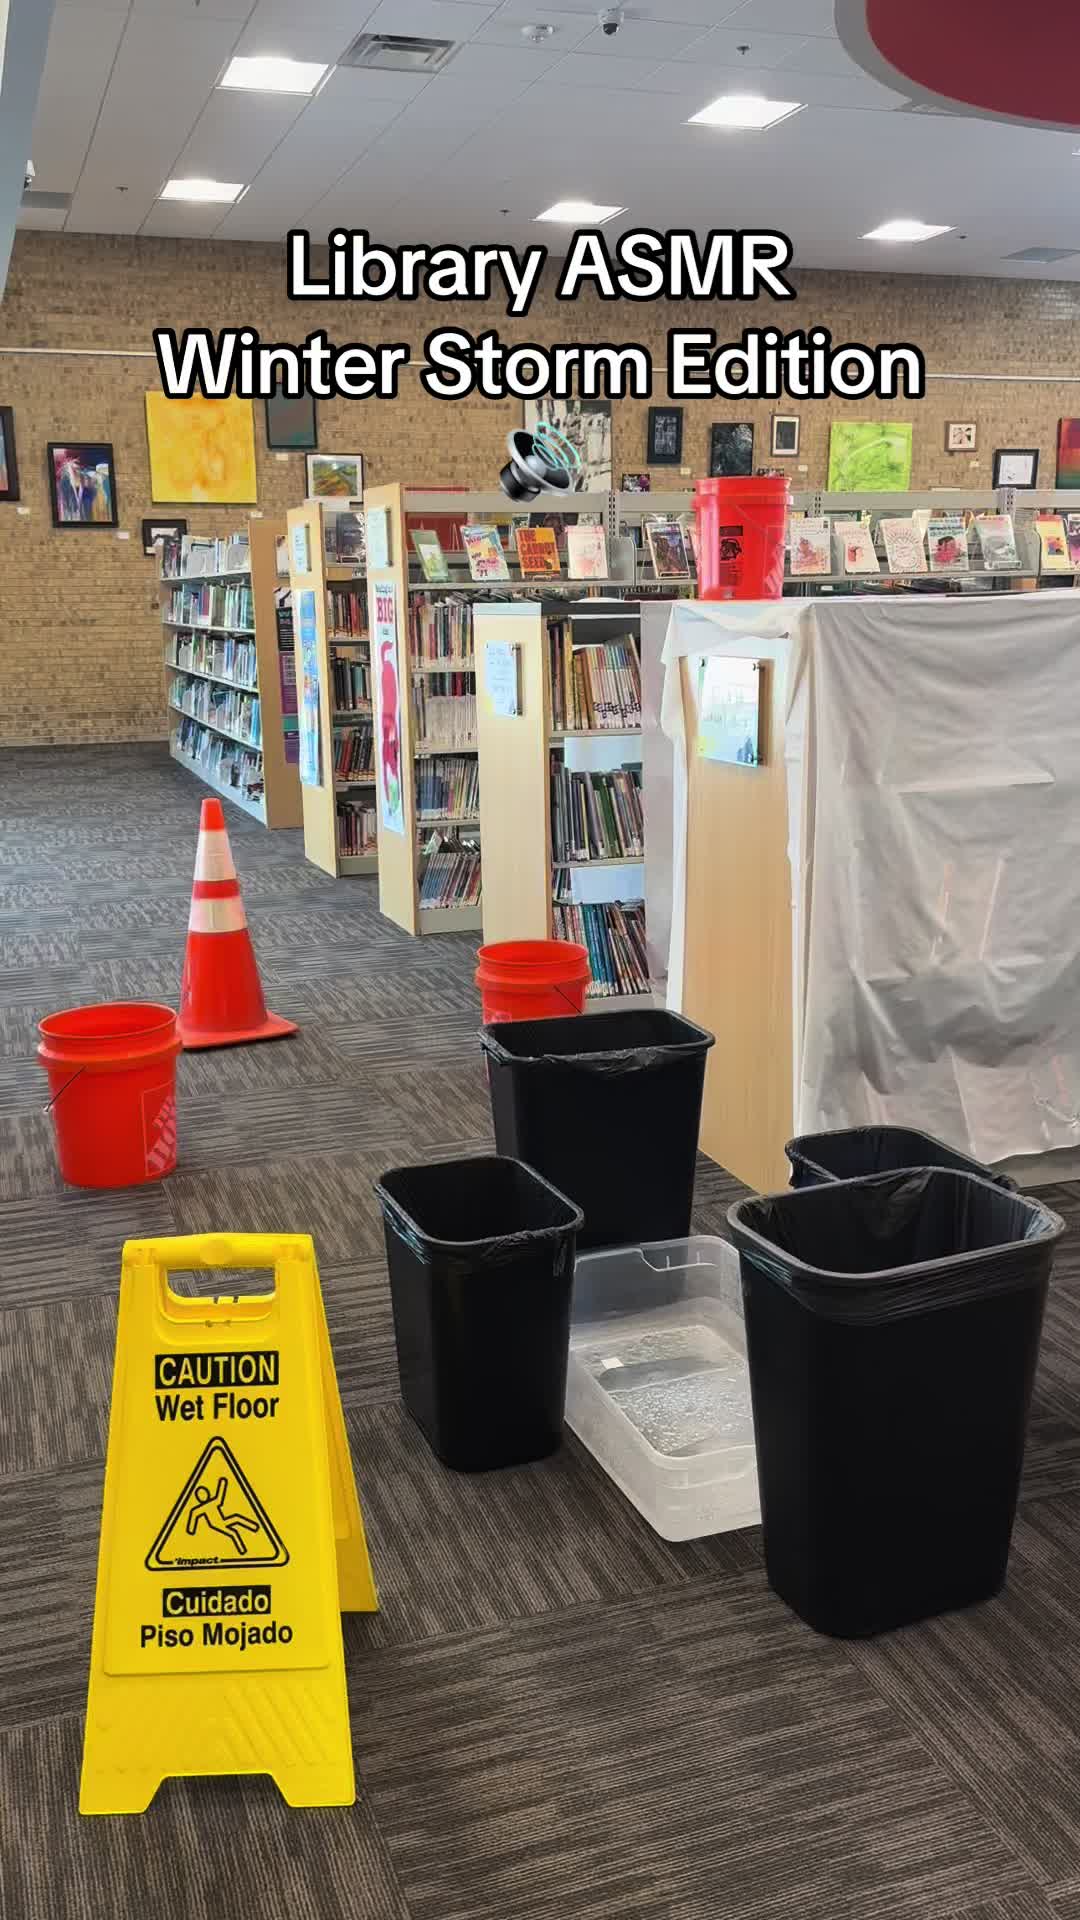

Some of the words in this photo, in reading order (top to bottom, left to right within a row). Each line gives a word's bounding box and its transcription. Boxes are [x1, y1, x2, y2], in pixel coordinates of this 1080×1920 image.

[376, 597, 393, 622] BIG
[159, 1354, 275, 1386] CAUTION
[155, 1394, 204, 1421] Wet
[213, 1392, 279, 1419] Floor
[166, 1589, 269, 1615] Cuidado
[140, 1624, 194, 1648] Piso
[203, 1620, 293, 1651] Mojado
